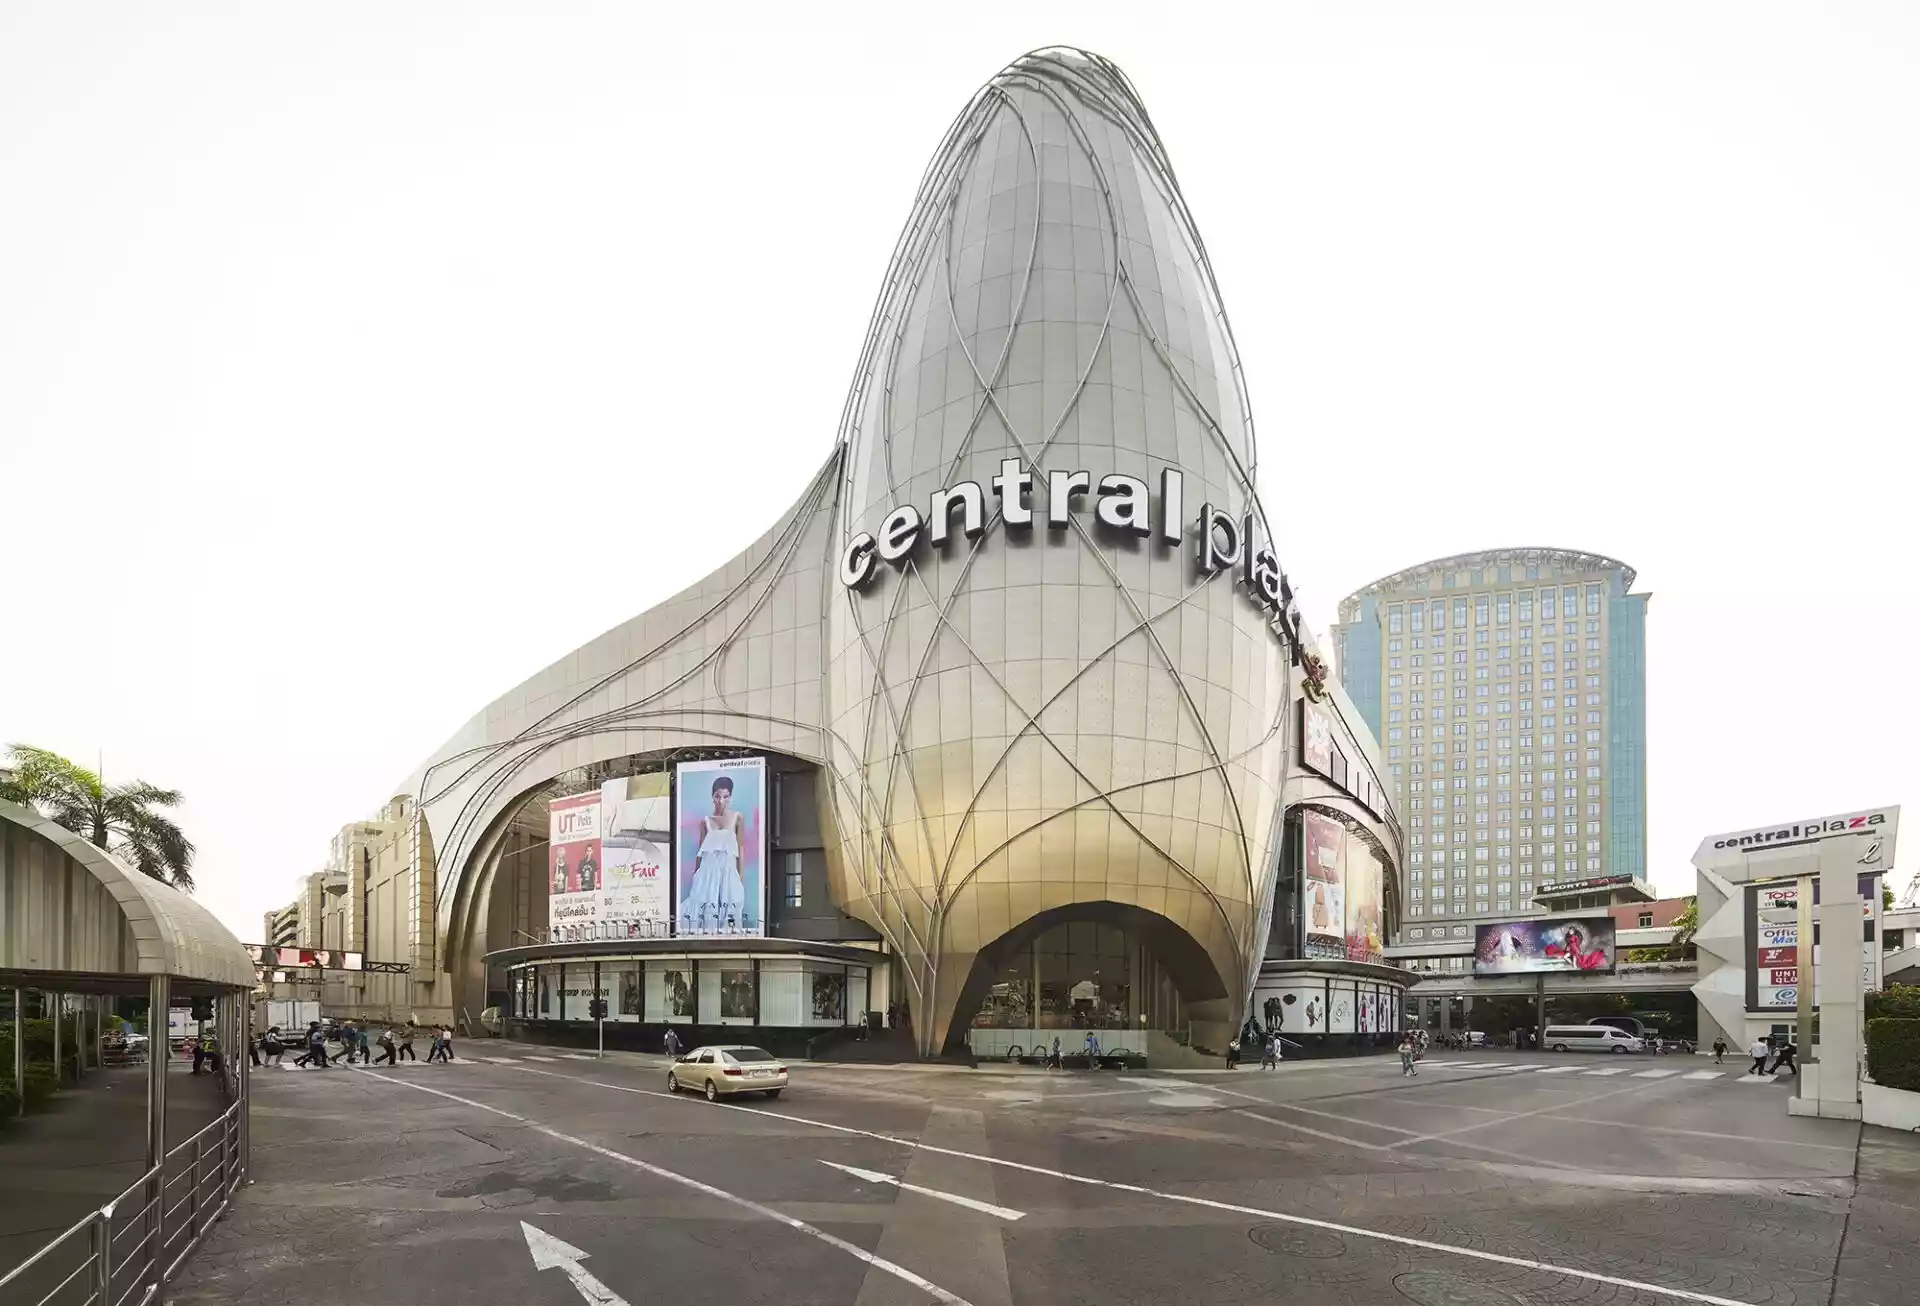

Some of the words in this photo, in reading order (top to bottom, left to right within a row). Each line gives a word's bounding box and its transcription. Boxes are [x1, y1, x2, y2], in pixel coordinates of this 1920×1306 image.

[839, 456, 1183, 590] central
[1714, 825, 1799, 850] central
[1804, 812, 1886, 838] plaza
[631, 861, 660, 878] Fair
